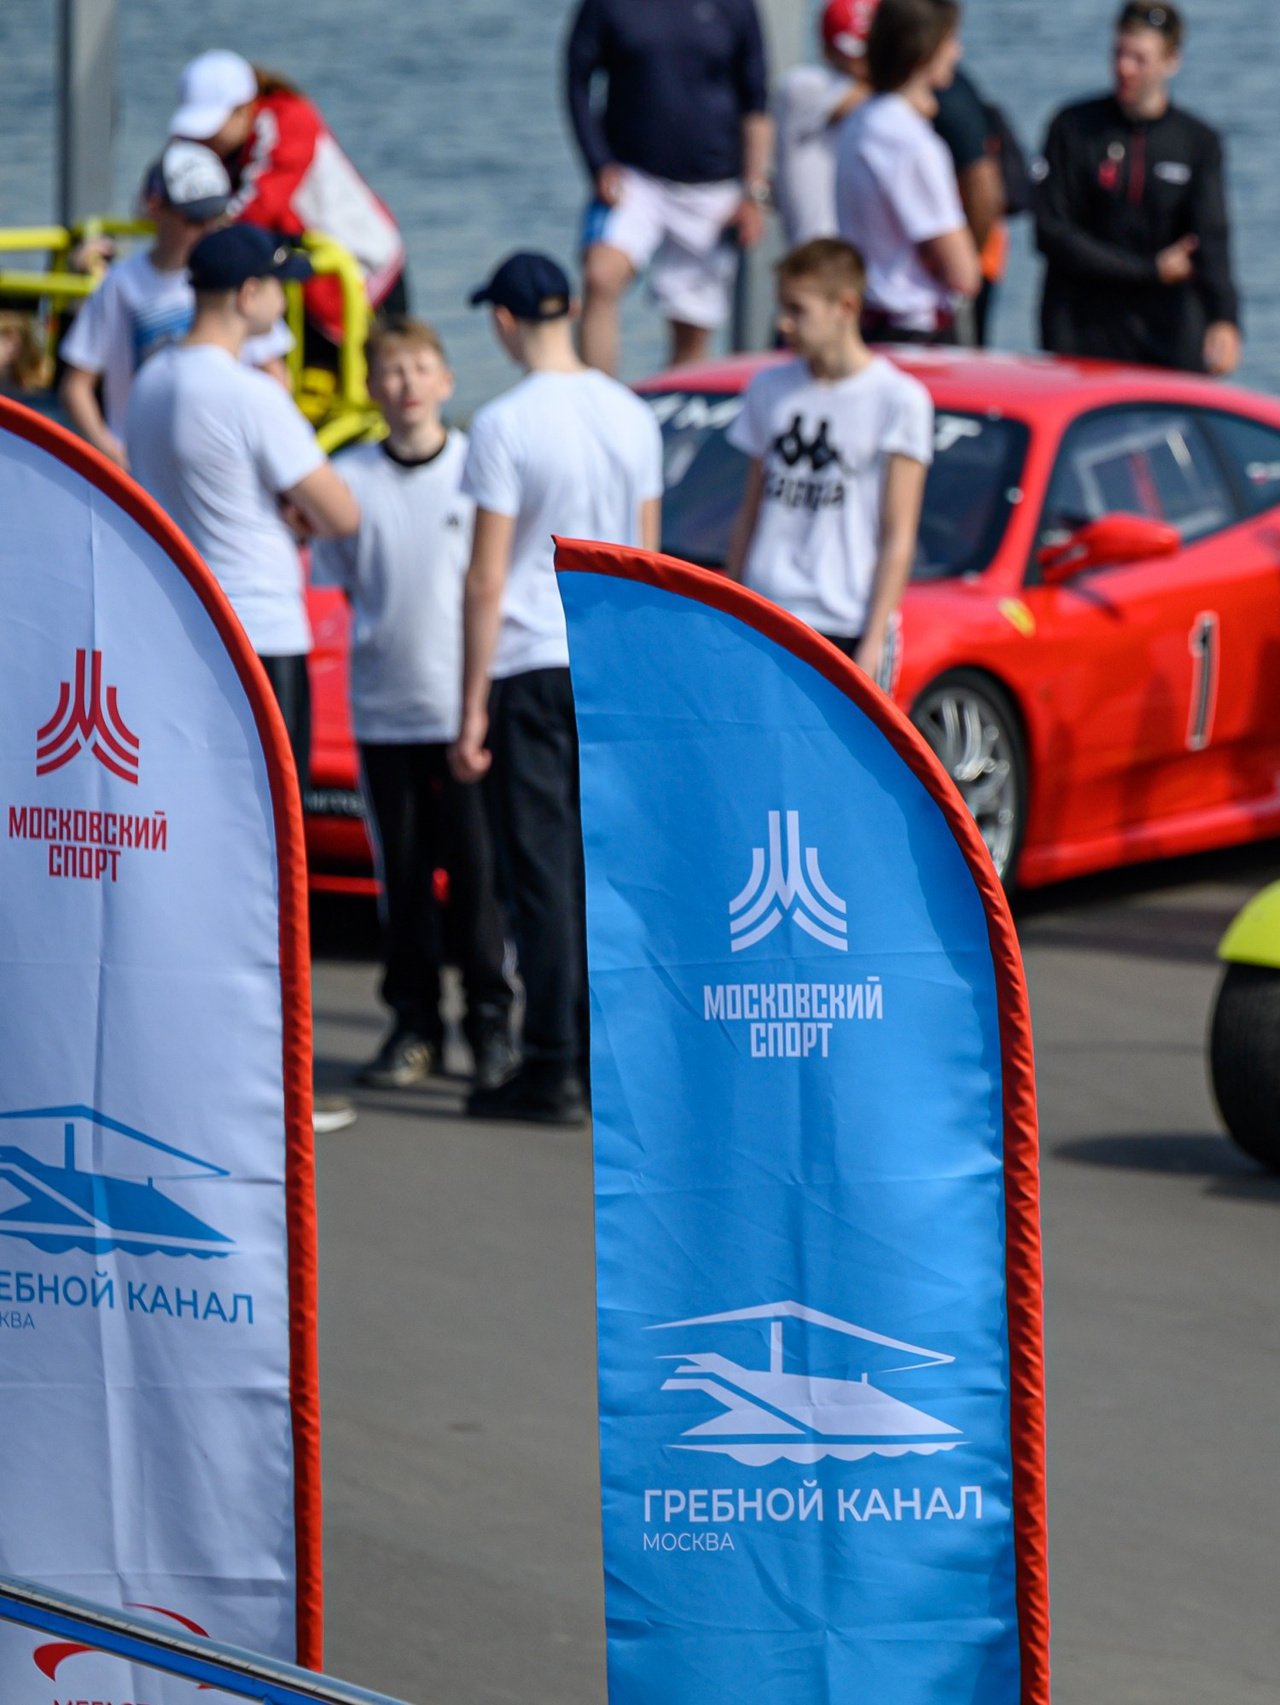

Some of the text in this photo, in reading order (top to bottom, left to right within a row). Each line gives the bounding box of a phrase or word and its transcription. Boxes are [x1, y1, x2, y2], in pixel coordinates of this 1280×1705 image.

[1185, 610, 1221, 752] 1
[8, 806, 167, 851] МОСКОВСКИЙ
[48, 844, 121, 882] СПОРТ
[703, 976, 883, 1020] МОСКОВСКИЙ
[750, 1022, 833, 1058] СПОРТ
[0, 1270, 254, 1325] ЕБНОЙ КАНАЛ
[0, 1310, 36, 1330] КВА
[643, 1479, 982, 1522] ГРЕБНОЙ КАНАЛ
[643, 1532, 735, 1552] МОСКВА
